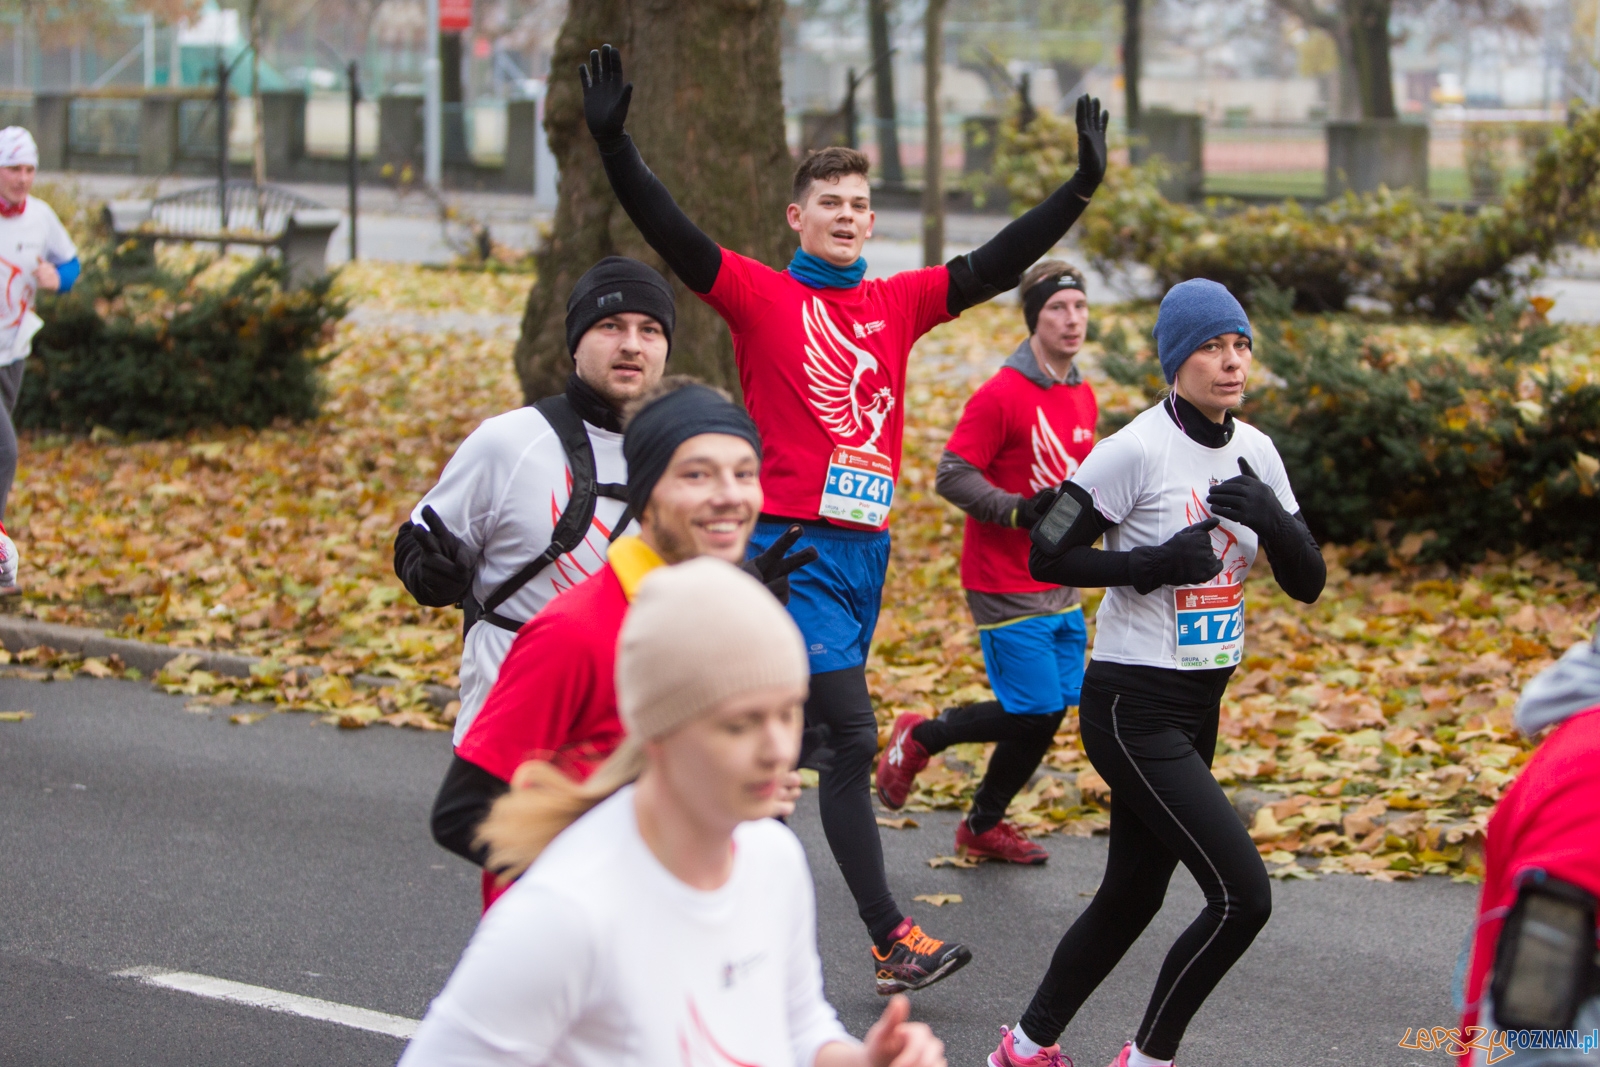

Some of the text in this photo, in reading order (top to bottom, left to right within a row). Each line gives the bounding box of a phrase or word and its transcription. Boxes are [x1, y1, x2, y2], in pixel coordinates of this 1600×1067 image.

[830, 472, 888, 503] E 6741
[1180, 624, 1189, 634] E
